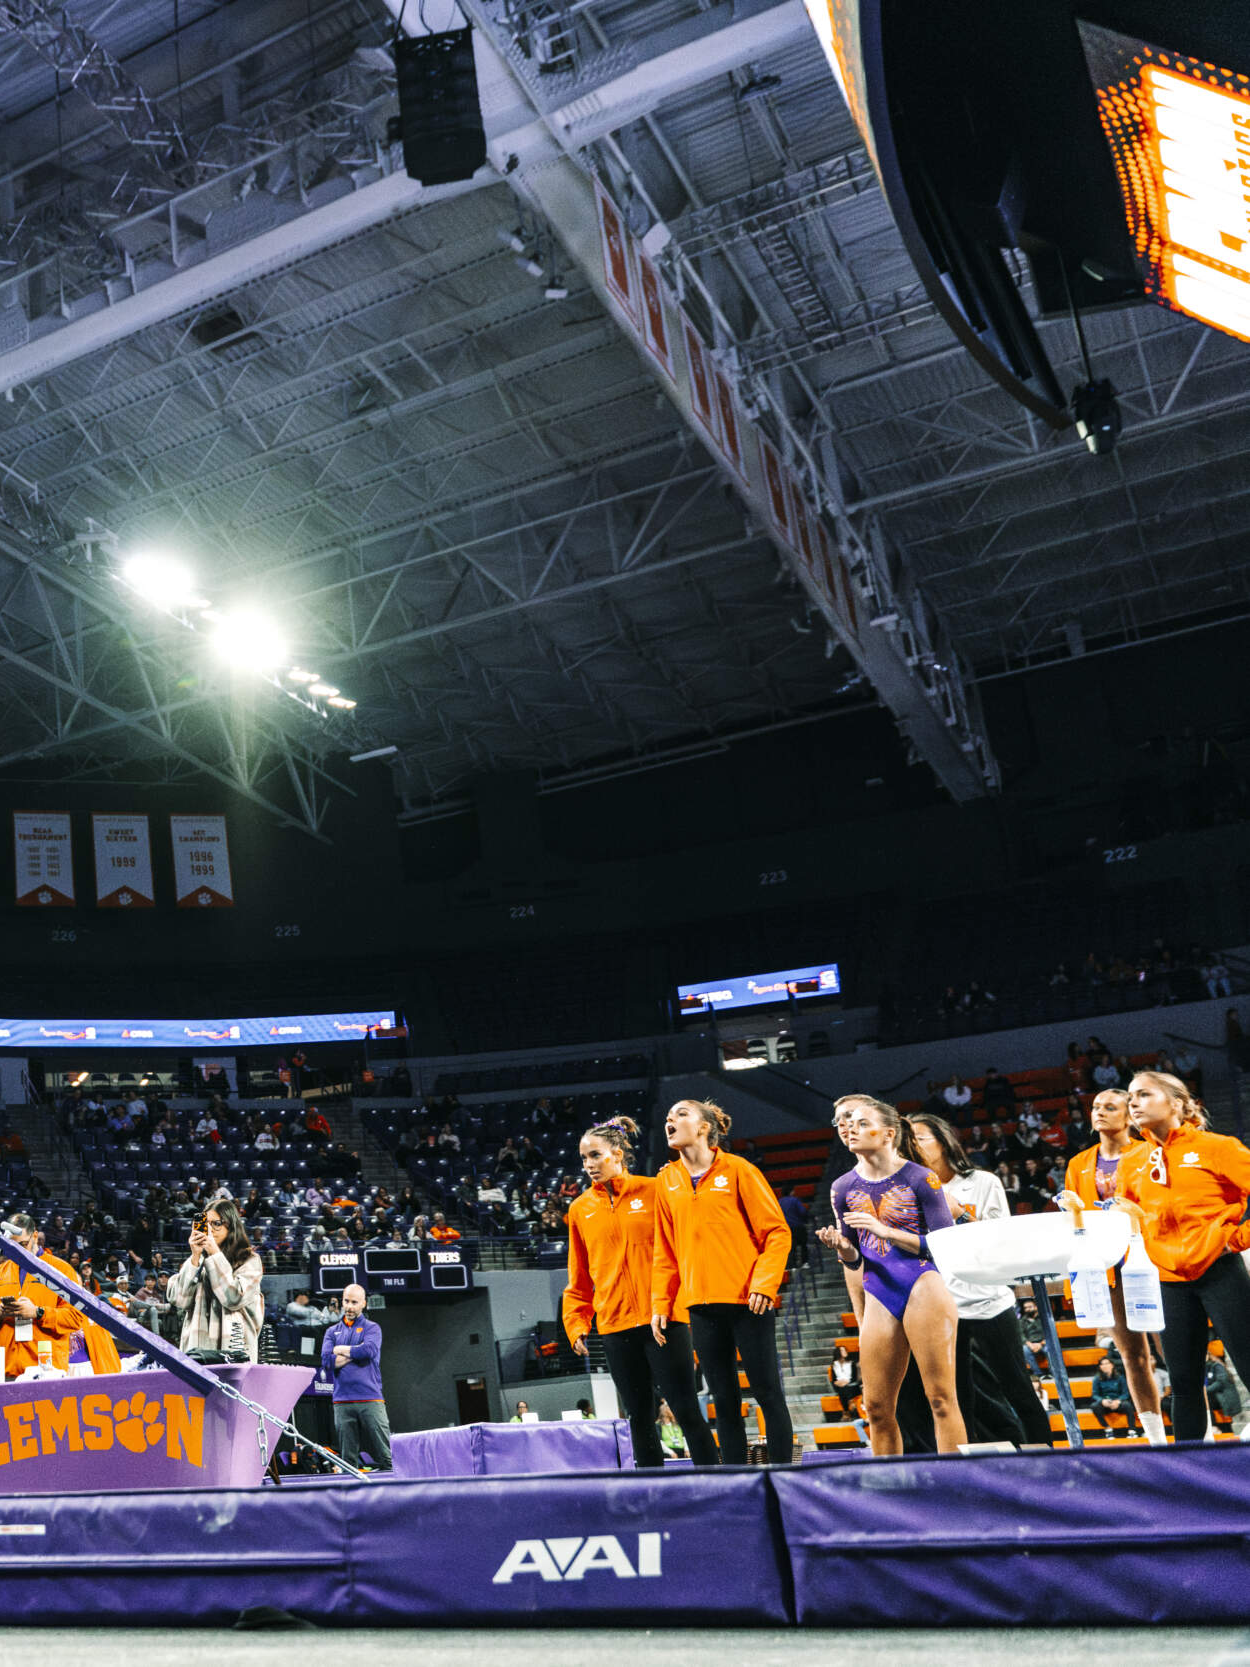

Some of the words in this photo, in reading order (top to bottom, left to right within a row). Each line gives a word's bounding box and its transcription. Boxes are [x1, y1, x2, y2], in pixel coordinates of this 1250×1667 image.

[1102, 845, 1139, 864] 222
[758, 868, 789, 886] 223
[274, 924, 301, 938] 225
[319, 1253, 359, 1266] CLEMSON
[427, 1251, 461, 1264] TIGERS
